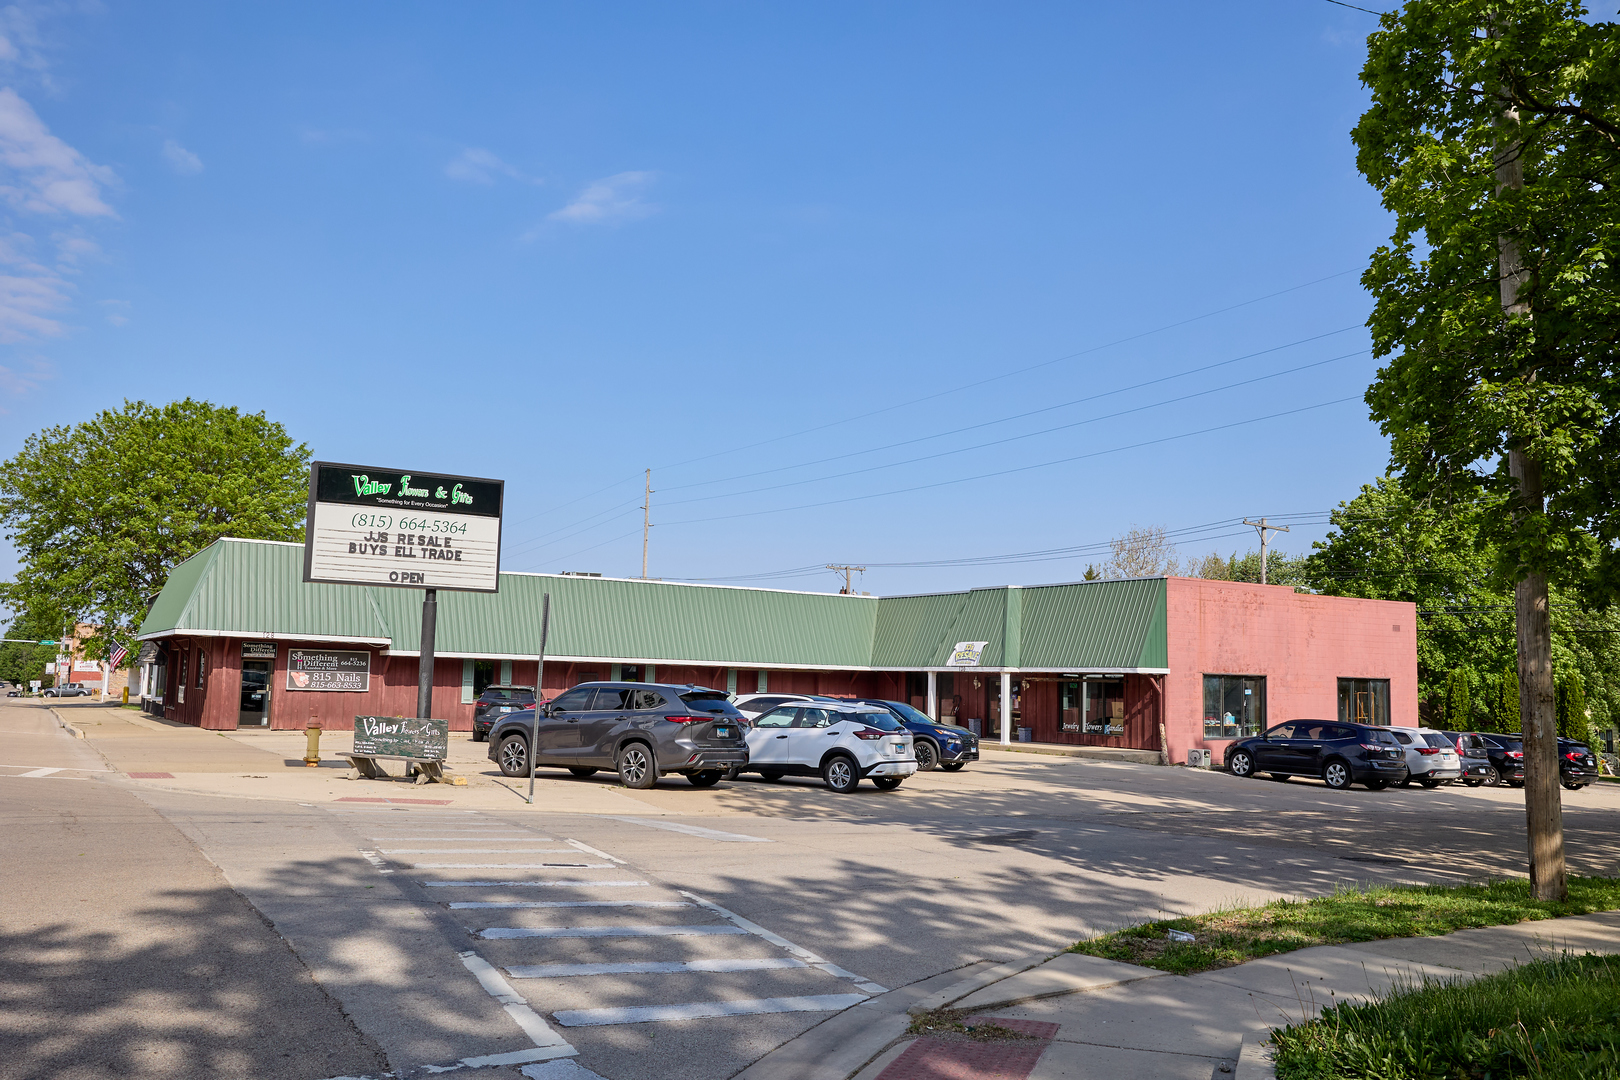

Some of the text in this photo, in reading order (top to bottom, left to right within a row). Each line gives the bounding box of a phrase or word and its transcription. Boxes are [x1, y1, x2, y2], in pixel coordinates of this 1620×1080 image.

[351, 474, 473, 504] Valley Flowers & Gifts
[411, 500, 425, 508] Every
[351, 512, 467, 535] (815) 664-5364
[364, 531, 389, 544] JJS
[348, 542, 463, 561] BUYS ELL TRADE
[389, 570, 425, 584] OPEN
[292, 652, 338, 662] Something
[312, 672, 361, 682] 815 Nails
[310, 681, 362, 689] 815-663-8533
[363, 717, 399, 736] Valley
